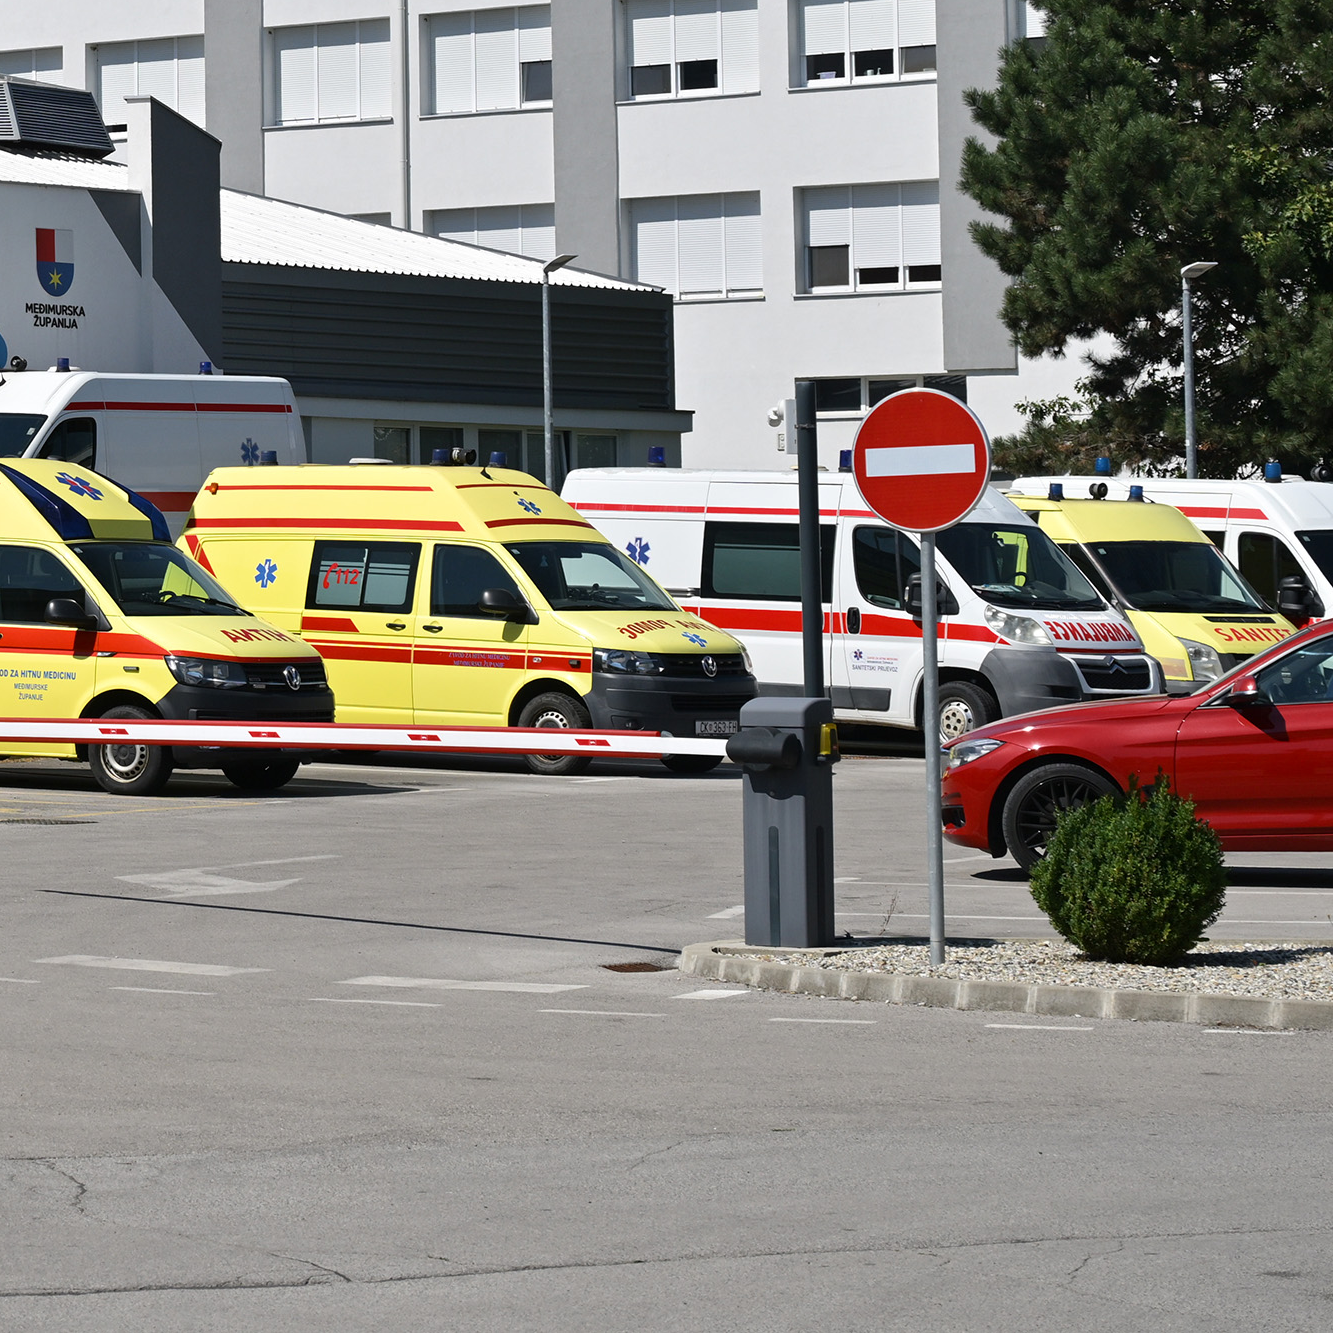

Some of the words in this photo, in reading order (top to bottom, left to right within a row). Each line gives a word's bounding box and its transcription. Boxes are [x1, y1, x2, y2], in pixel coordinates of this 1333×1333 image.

[25, 302, 86, 317] MEĐIMURSKA
[33, 314, 78, 329] ŽUPANIJA
[335, 568, 360, 585] 112
[10, 669, 19, 677] ZA
[21, 670, 41, 679] HITNU
[43, 671, 77, 680] MEDICINU
[18, 692, 44, 700] ŽUPANIJE
